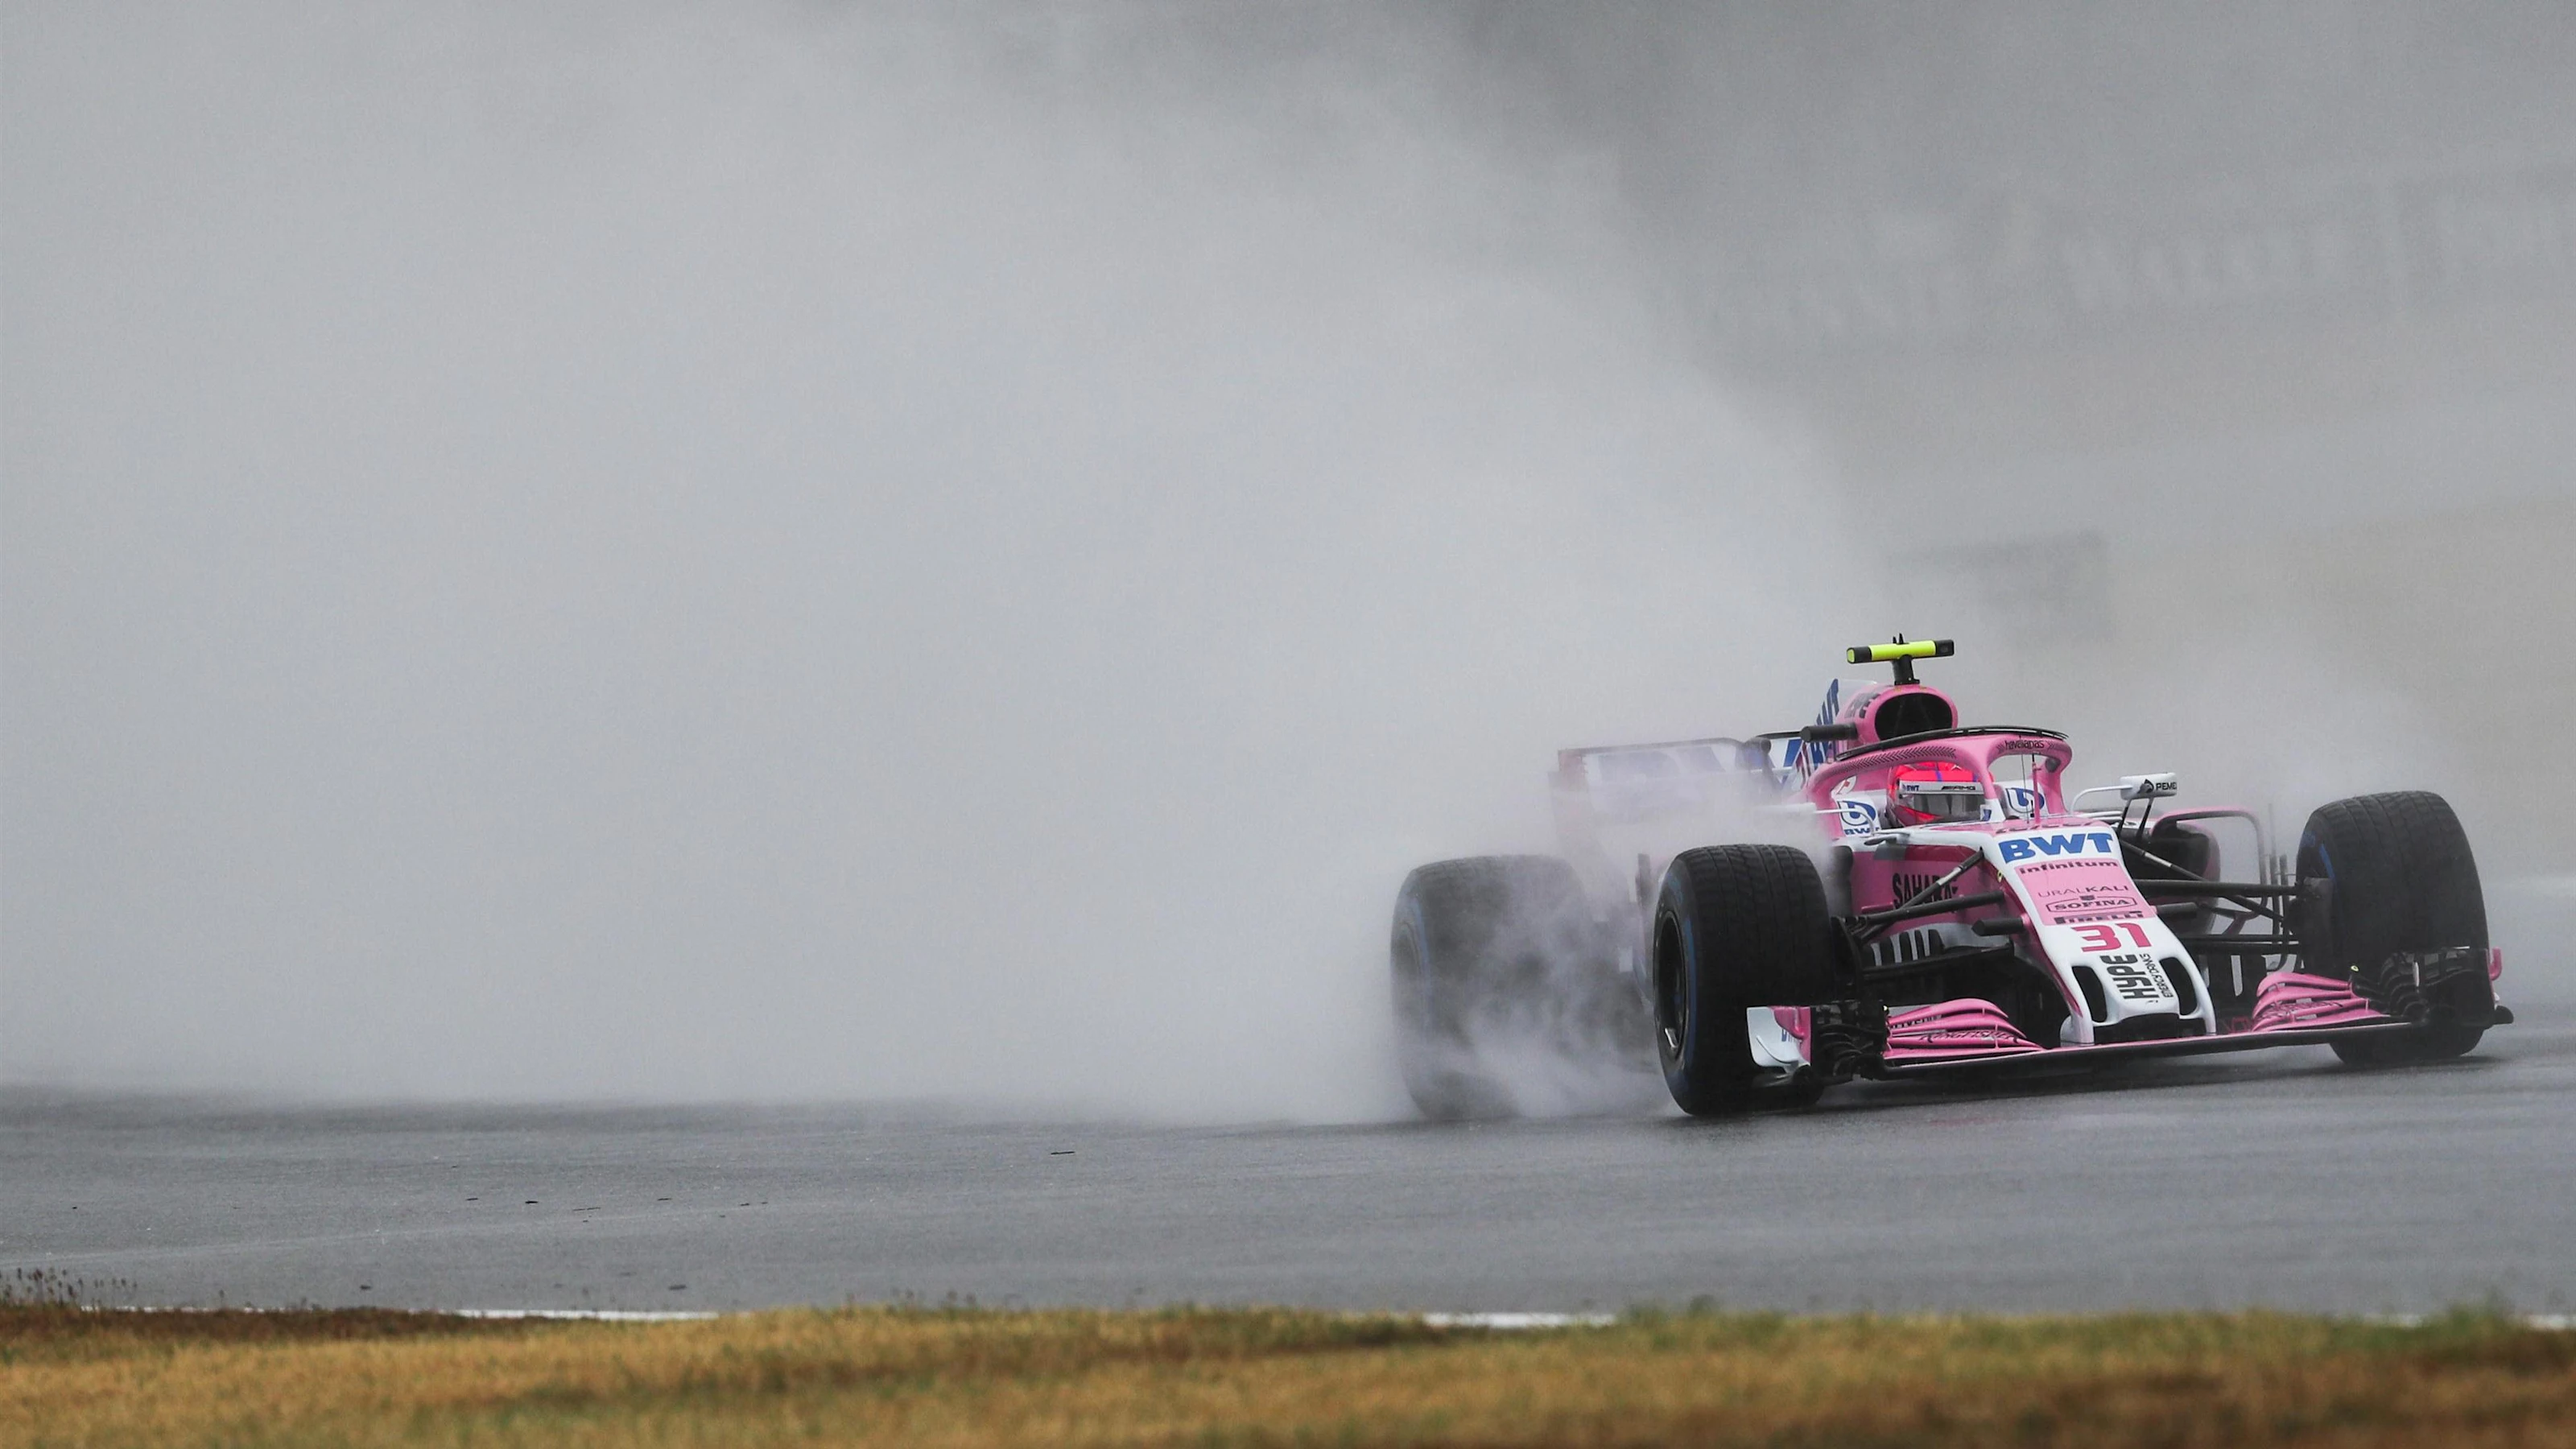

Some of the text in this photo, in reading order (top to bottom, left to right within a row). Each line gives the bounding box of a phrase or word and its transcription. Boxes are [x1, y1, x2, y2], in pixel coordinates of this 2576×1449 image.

[1997, 832, 2114, 864] BWT
[2019, 860, 2119, 874] infinitum
[2037, 884, 2128, 898] URALKALI
[2054, 898, 2130, 910] SOFINA
[2070, 923, 2153, 952] 31
[2099, 954, 2160, 1000] HYPE
